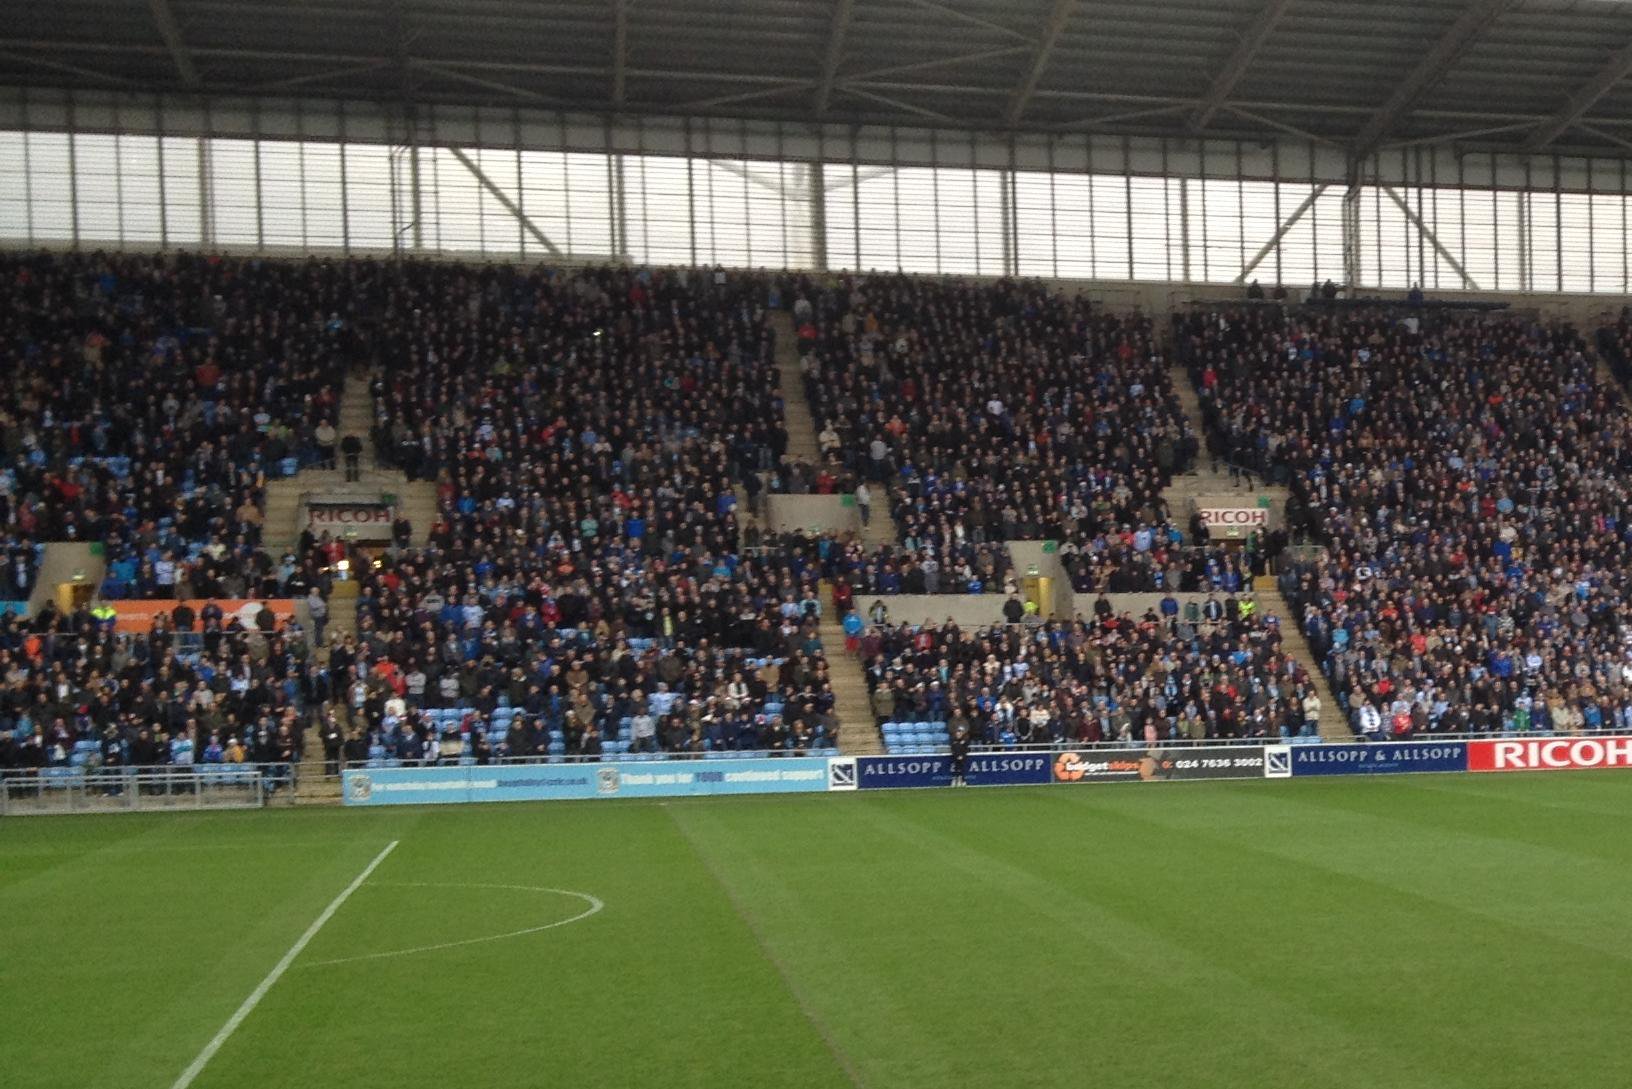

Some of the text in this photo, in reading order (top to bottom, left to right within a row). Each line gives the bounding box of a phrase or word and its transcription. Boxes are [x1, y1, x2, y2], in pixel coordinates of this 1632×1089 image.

[309, 508, 390, 522] RICOH
[1200, 511, 1265, 523] RICOH
[1298, 747, 1461, 762] ALLSOPP & ALLSOPP
[864, 761, 943, 775] ALLSOPP
[969, 759, 1045, 773] ALLSOPP
